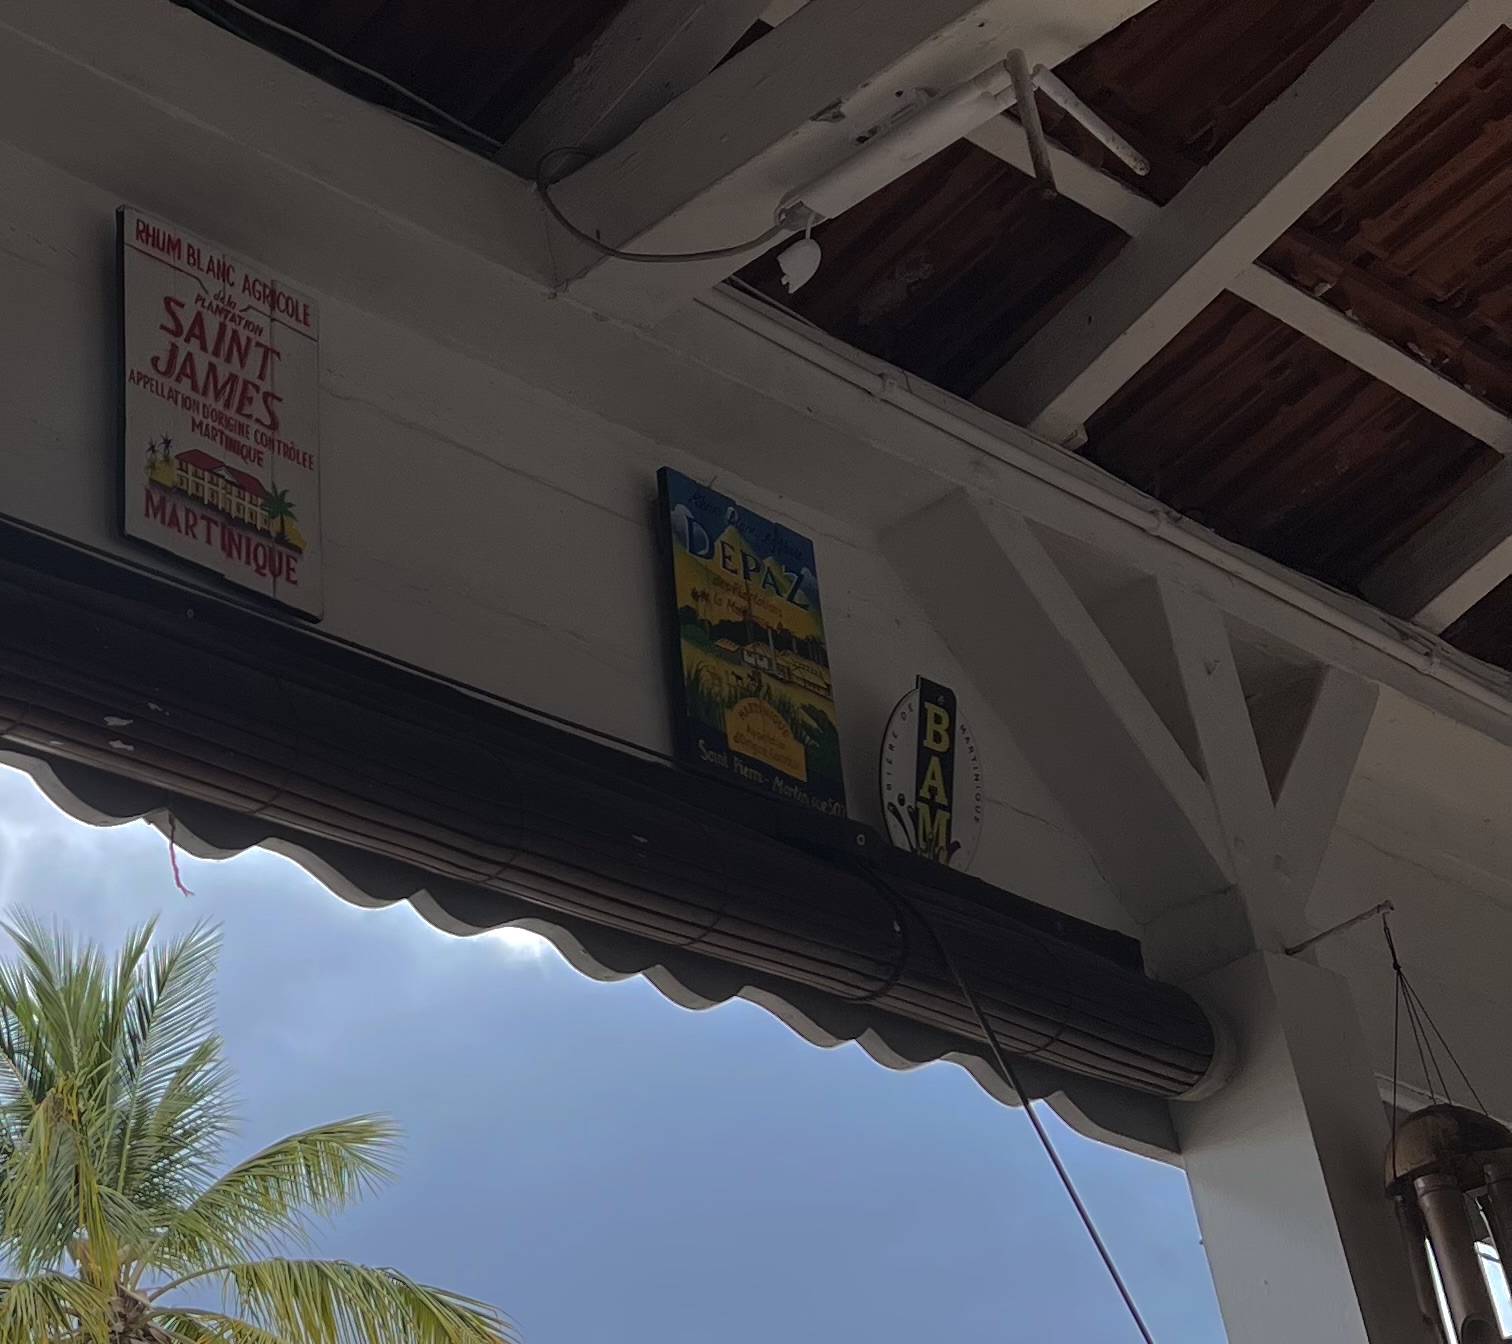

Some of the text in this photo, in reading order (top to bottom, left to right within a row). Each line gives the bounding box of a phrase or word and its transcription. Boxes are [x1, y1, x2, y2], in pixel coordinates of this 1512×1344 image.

[134, 217, 312, 329] RHUM BLANC AGRICOLE
[194, 293, 264, 337] PLANTATION
[150, 341, 283, 432] JAMES
[159, 295, 282, 383] SAINT
[128, 368, 200, 416] APPELLATION
[202, 402, 251, 441] D'ORIGINE
[190, 416, 265, 469] MARTINIQUE
[143, 486, 299, 586] MARTINIQUE
[685, 514, 811, 613] DEPAZ
[916, 700, 953, 864] BAM
[958, 724, 983, 824] MARTINIQUE
